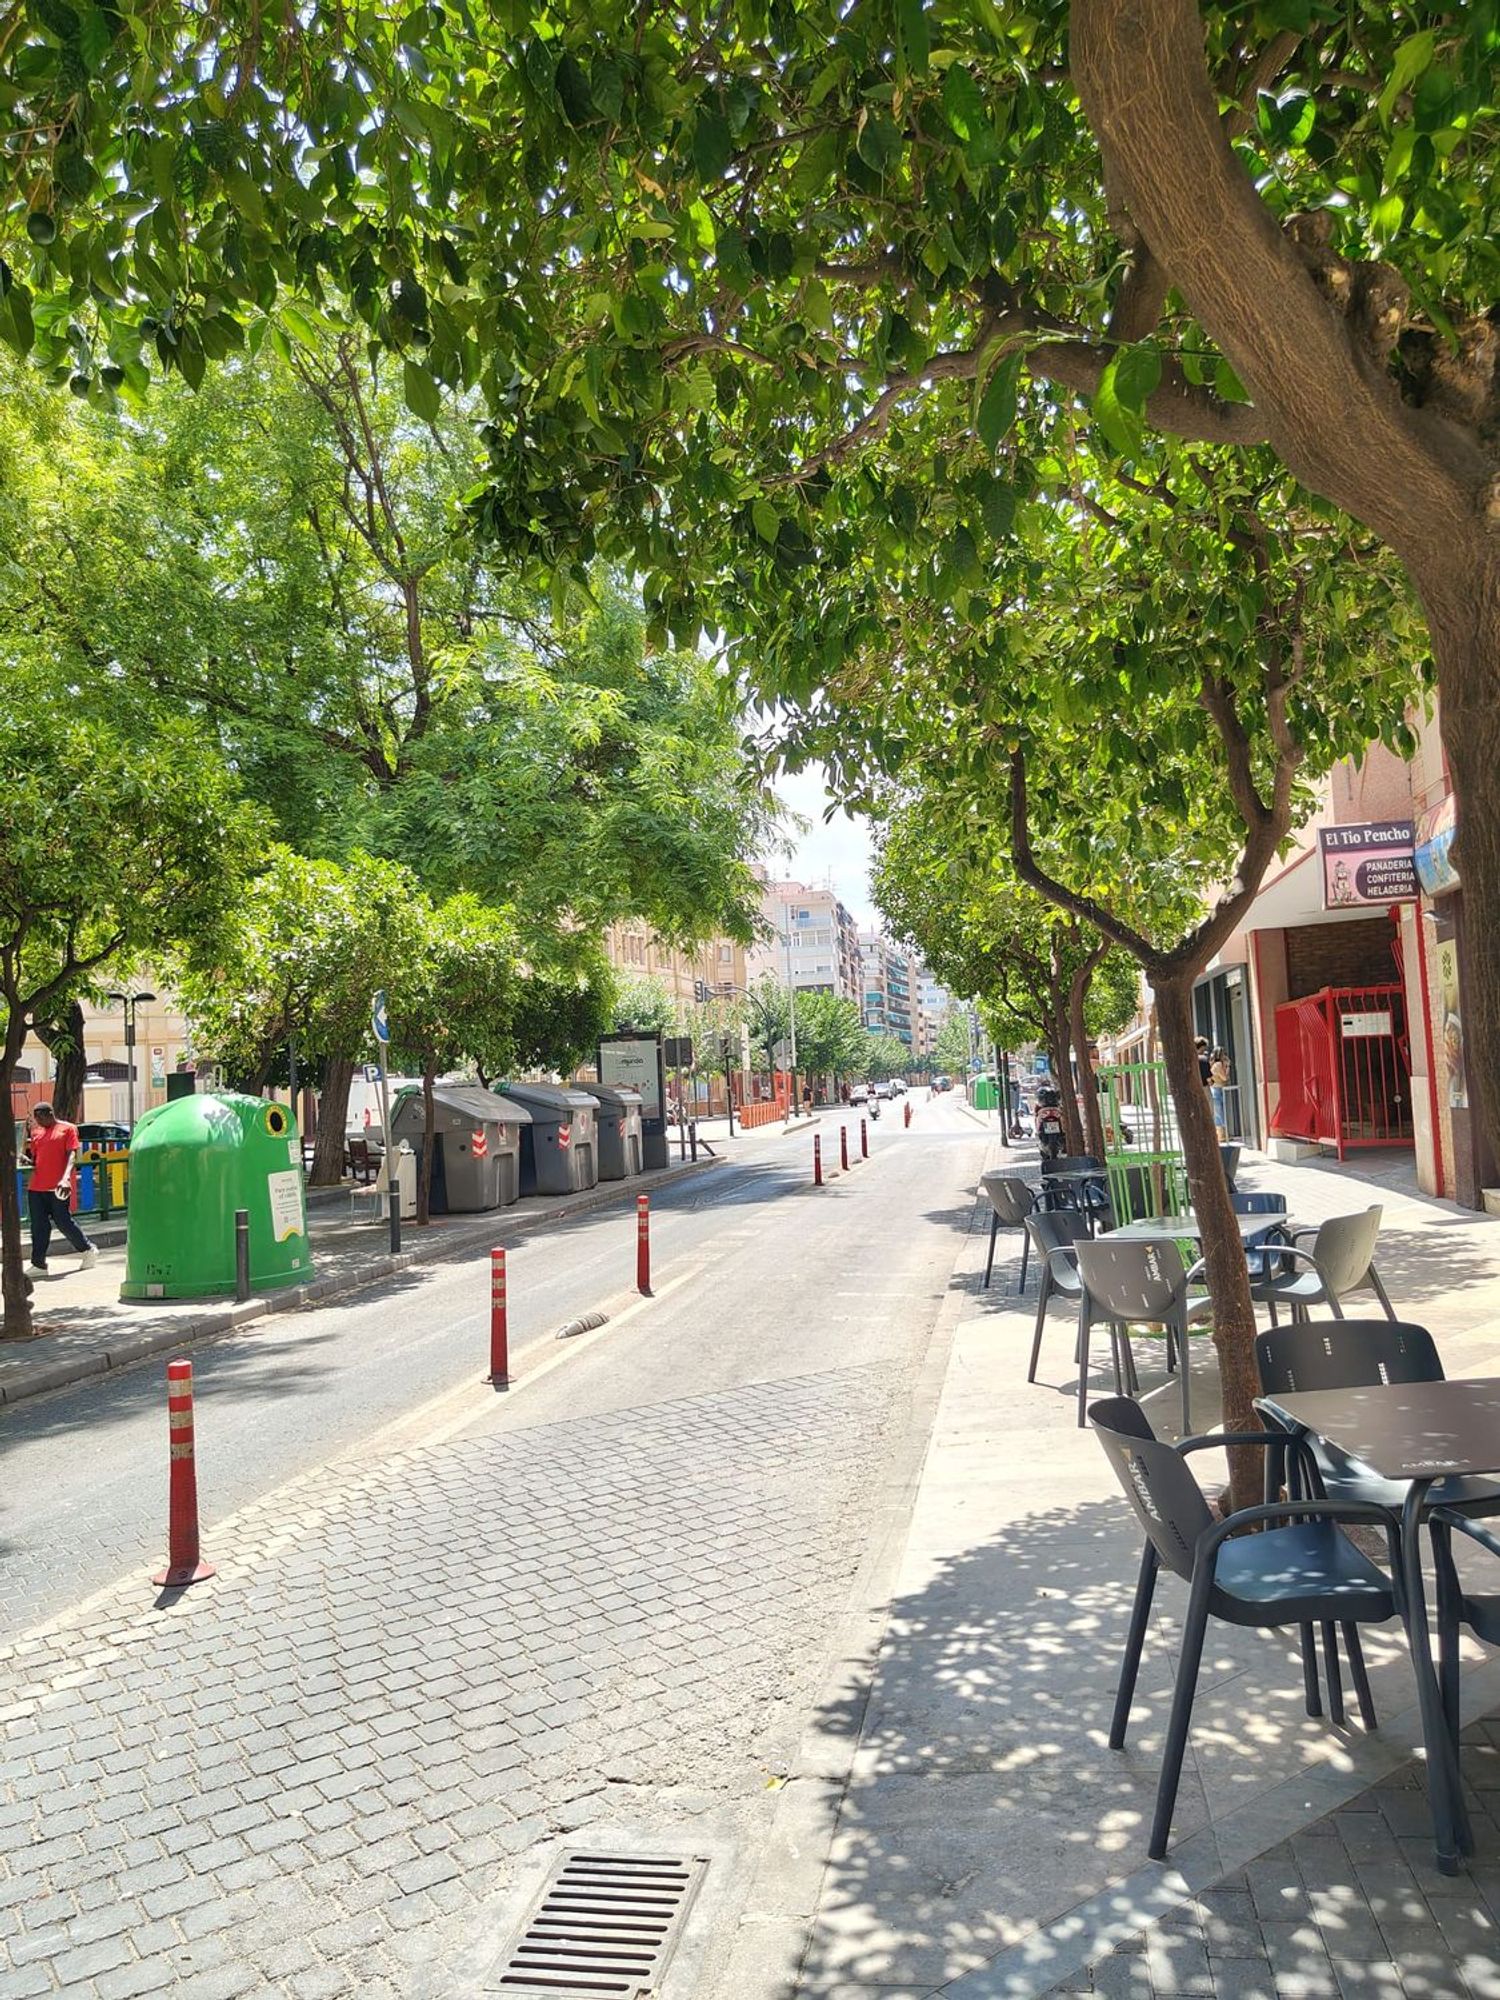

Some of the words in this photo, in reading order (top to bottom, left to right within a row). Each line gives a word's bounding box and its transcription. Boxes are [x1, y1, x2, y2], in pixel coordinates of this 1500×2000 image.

[1325, 832, 1339, 846] El
[1341, 830, 1361, 844] Tio
[1363, 826, 1410, 843] Pencho
[1366, 860, 1413, 871] PANADERIA
[1366, 872, 1415, 884] CONFITERIA
[1367, 884, 1413, 895] HELADERIA
[368, 1066, 378, 1082] P
[1128, 1462, 1162, 1522] AMBAR
